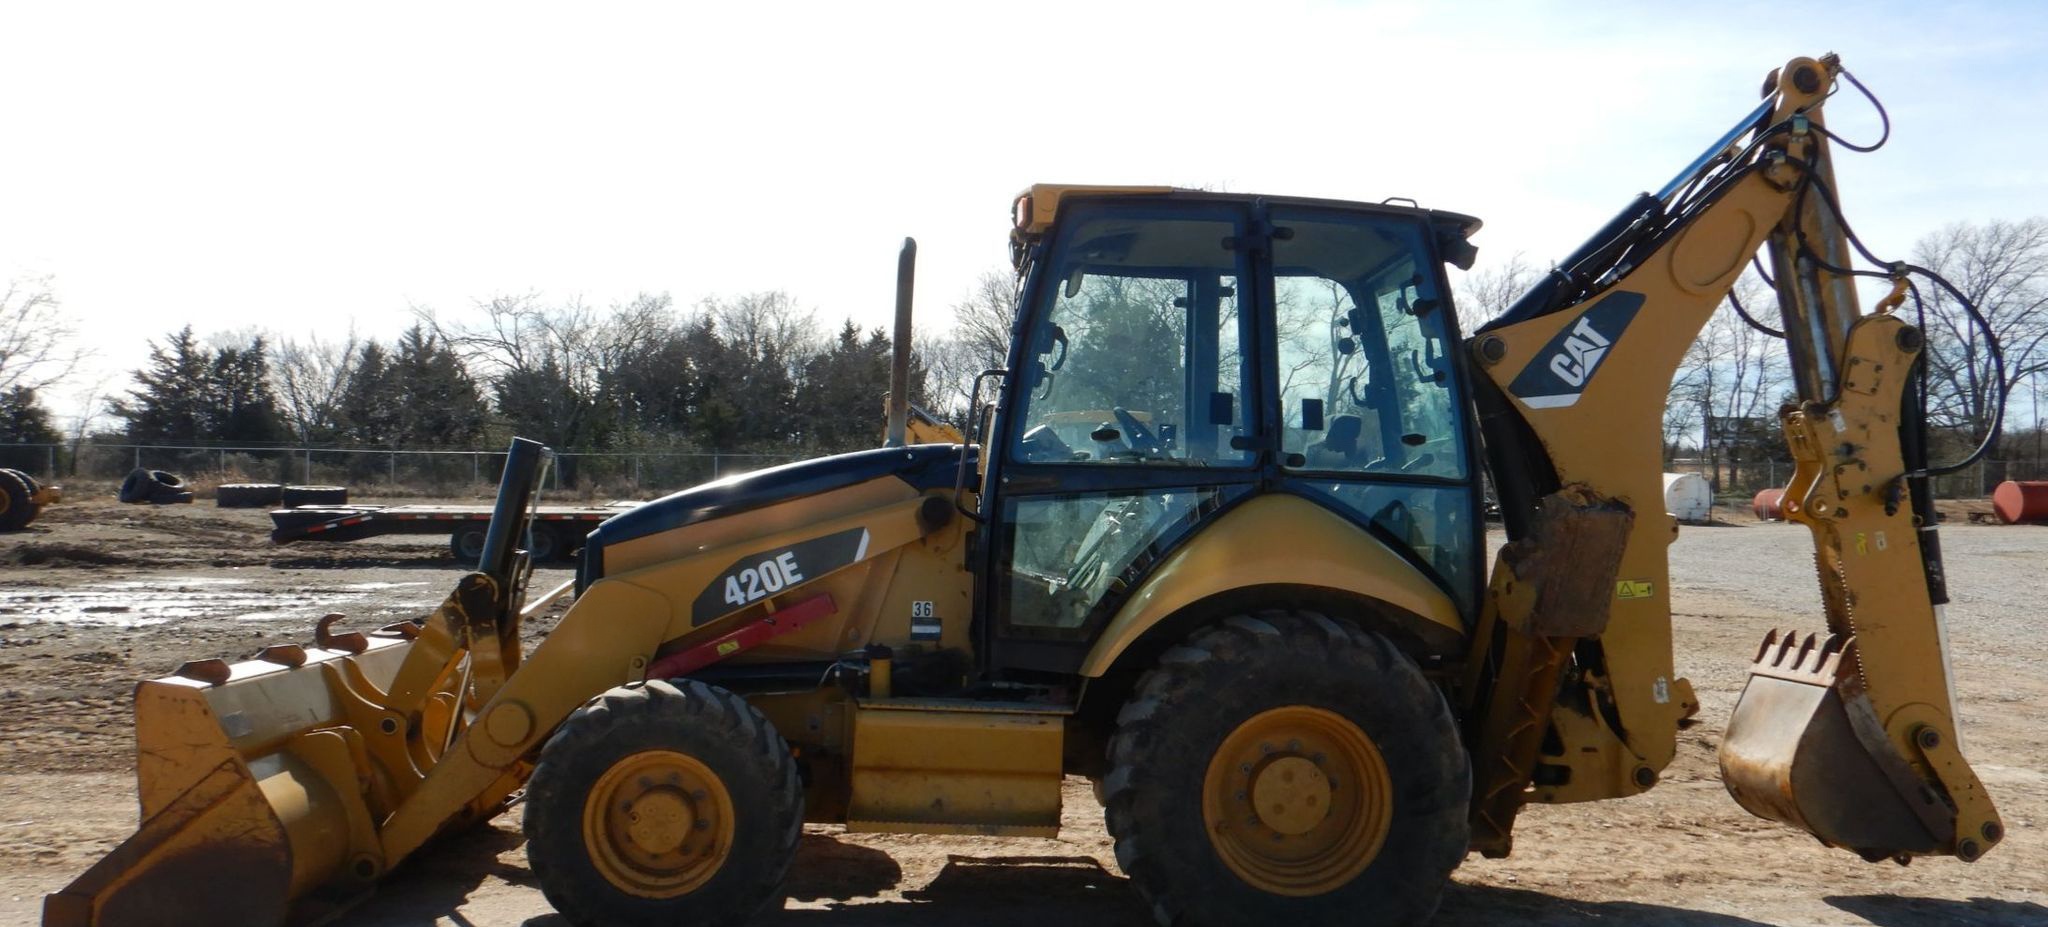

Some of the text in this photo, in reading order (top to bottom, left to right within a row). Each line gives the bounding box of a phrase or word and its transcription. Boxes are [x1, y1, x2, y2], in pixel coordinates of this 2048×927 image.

[1551, 316, 1611, 387] CAT
[724, 551, 803, 606] 420E
[914, 602, 931, 617] 36
